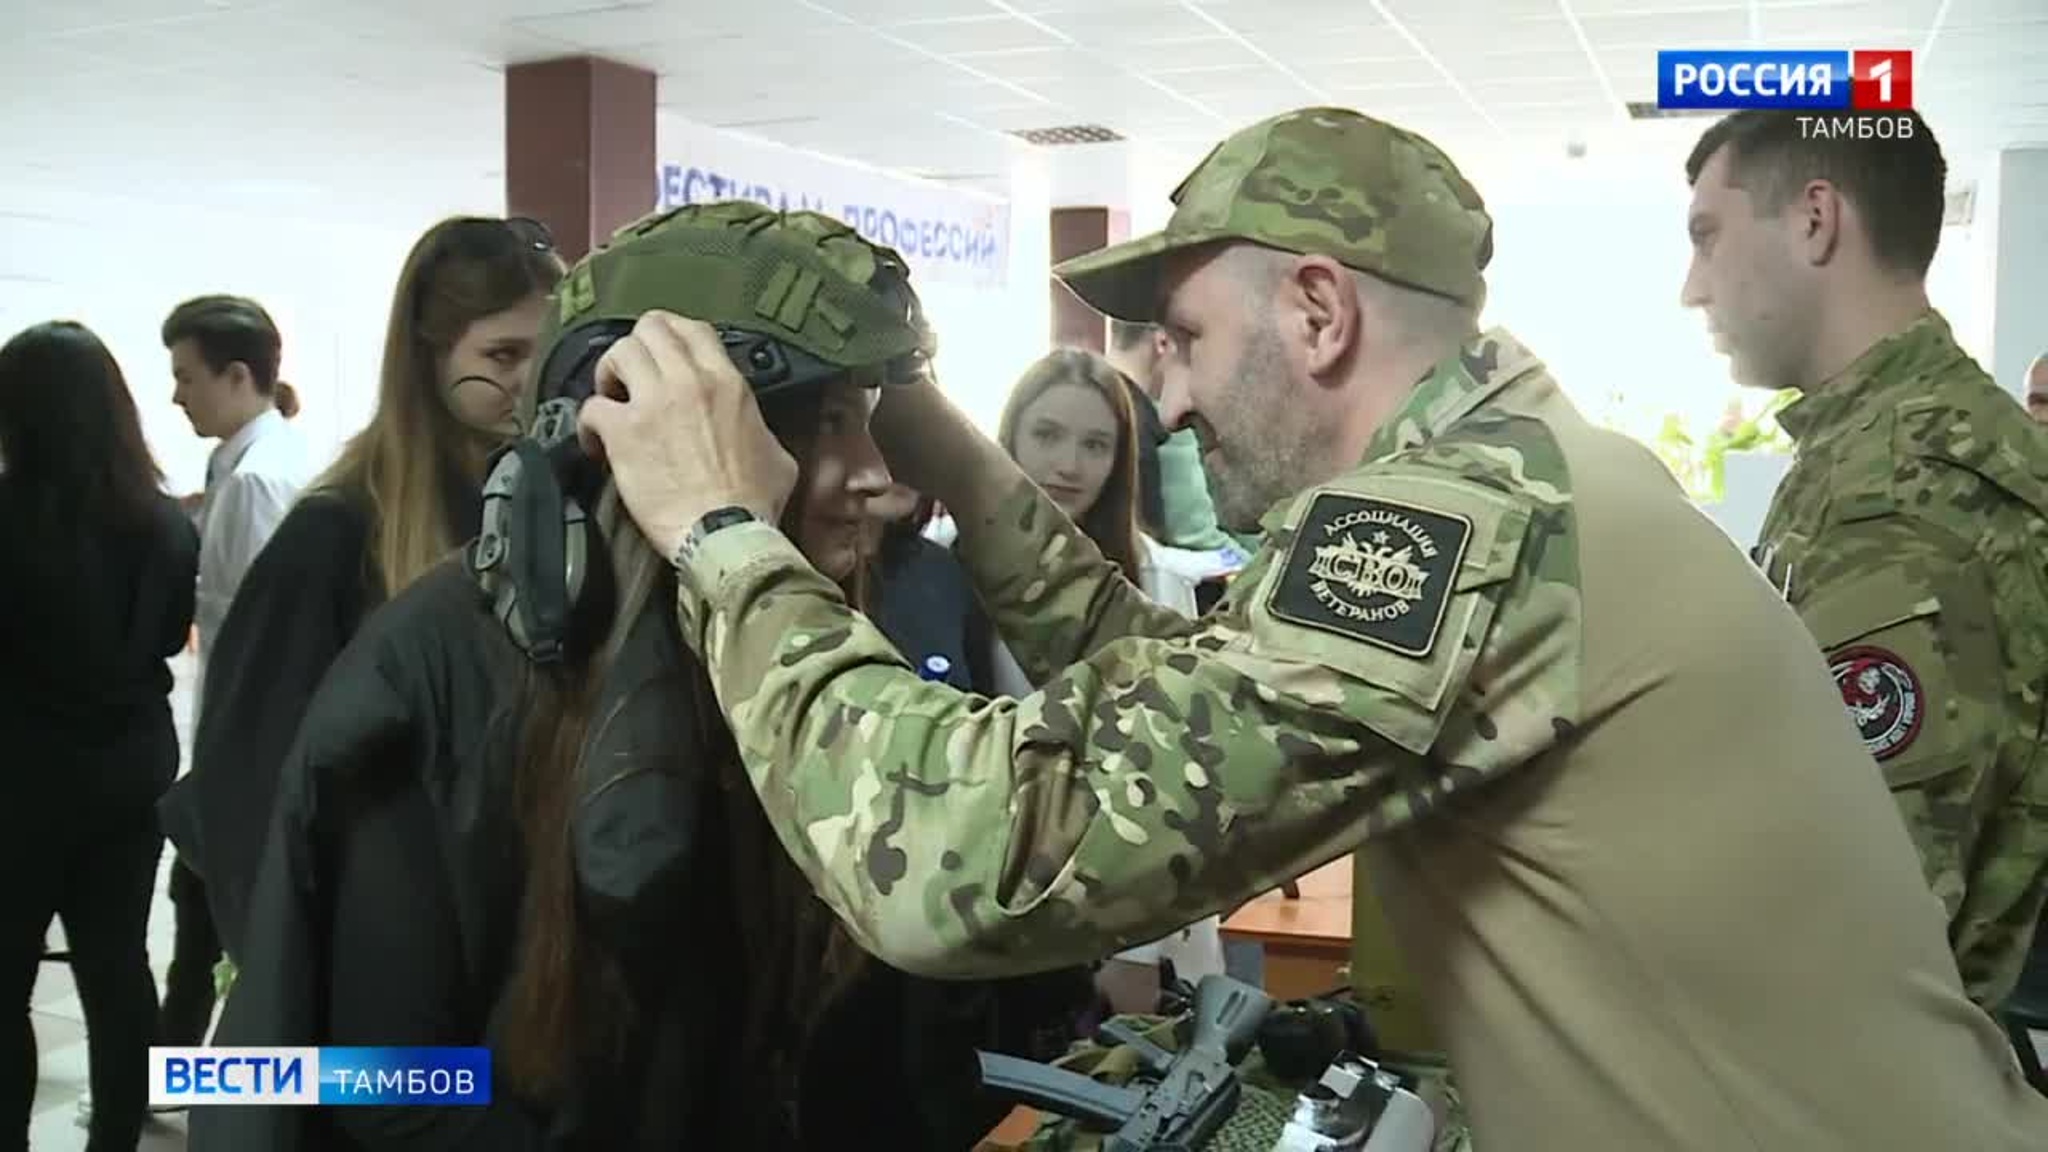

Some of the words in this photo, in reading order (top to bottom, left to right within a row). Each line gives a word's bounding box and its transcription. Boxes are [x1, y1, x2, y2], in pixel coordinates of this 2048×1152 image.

[656, 164, 823, 211] ЕСТИВ
[843, 204, 997, 263] ПРОФЕССИЙ
[1328, 553, 1411, 592] СВО
[1309, 580, 1411, 622] ВЕТЕРАНОВ
